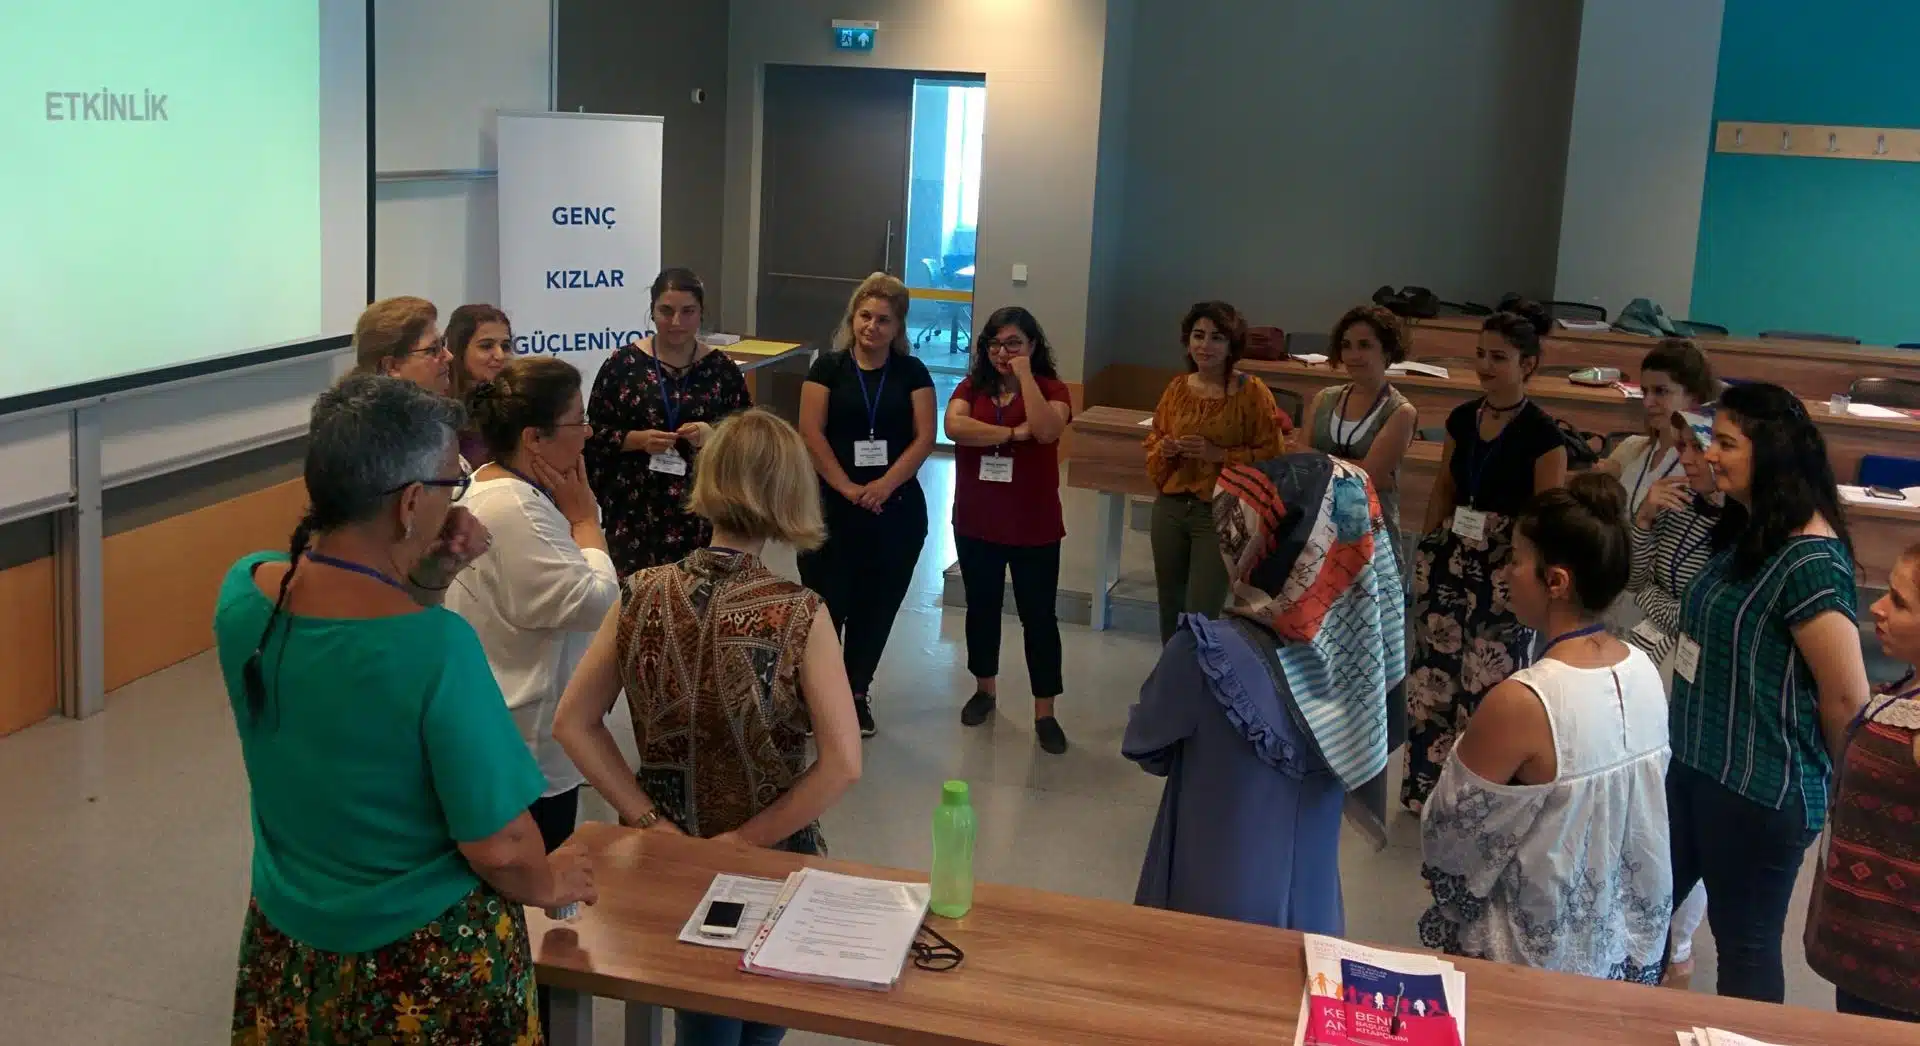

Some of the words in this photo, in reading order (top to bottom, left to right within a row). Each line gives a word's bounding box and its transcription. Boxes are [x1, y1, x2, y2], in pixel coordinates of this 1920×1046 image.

[45, 86, 169, 121] ETKİNLİK
[552, 206, 616, 230] GENÇ
[546, 269, 624, 289] KIZLAR
